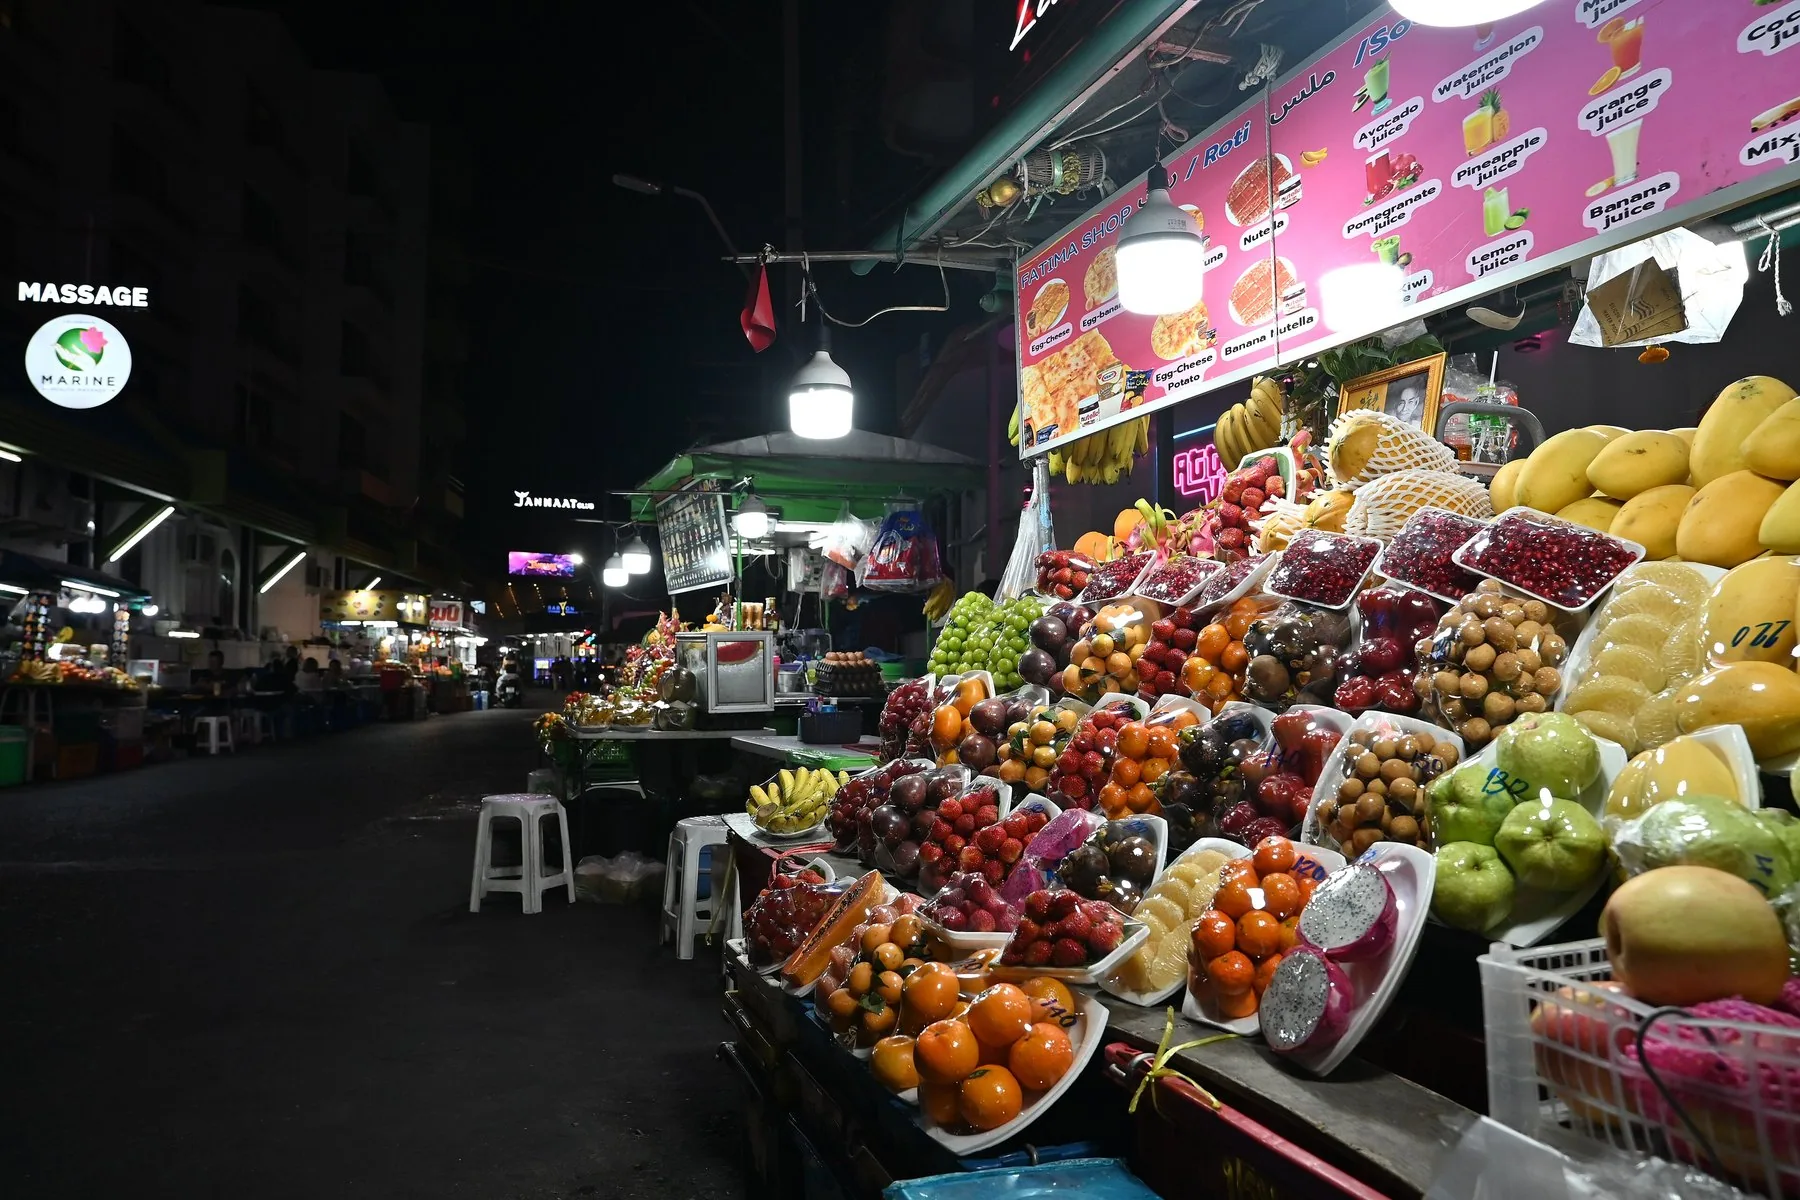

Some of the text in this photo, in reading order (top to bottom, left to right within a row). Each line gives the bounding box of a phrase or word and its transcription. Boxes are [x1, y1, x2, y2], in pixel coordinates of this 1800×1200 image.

[1437, 34, 1537, 96] Watermelon
[1463, 62, 1504, 95] juice
[1358, 103, 1419, 143] Avocado
[1596, 97, 1649, 131] juice
[1370, 122, 1404, 149] juice
[1457, 135, 1541, 182] Pineapple
[1476, 158, 1518, 187] juice
[1021, 243, 1078, 290] FATIMA
[1082, 206, 1132, 249] SHOP
[1203, 121, 1251, 168] Roti
[1346, 185, 1436, 234] Pomegranate
[1590, 181, 1671, 219] Banana
[1373, 211, 1406, 234] juice
[1602, 199, 1656, 230] juice
[1201, 251, 1224, 267] una
[1472, 237, 1528, 265] Lemon
[1478, 252, 1520, 277] juice
[18, 281, 149, 307] MASSAGE
[1031, 327, 1071, 352] Egg-Cheese
[1224, 333, 1267, 356] Banana
[42, 375, 116, 386] MARINE
[1155, 353, 1213, 382] Egg-Cheese
[1167, 373, 1201, 391] Potato
[514, 490, 578, 509] JANNAAT
[1292, 855, 1327, 882] 120
[1040, 998, 1078, 1028] 140
